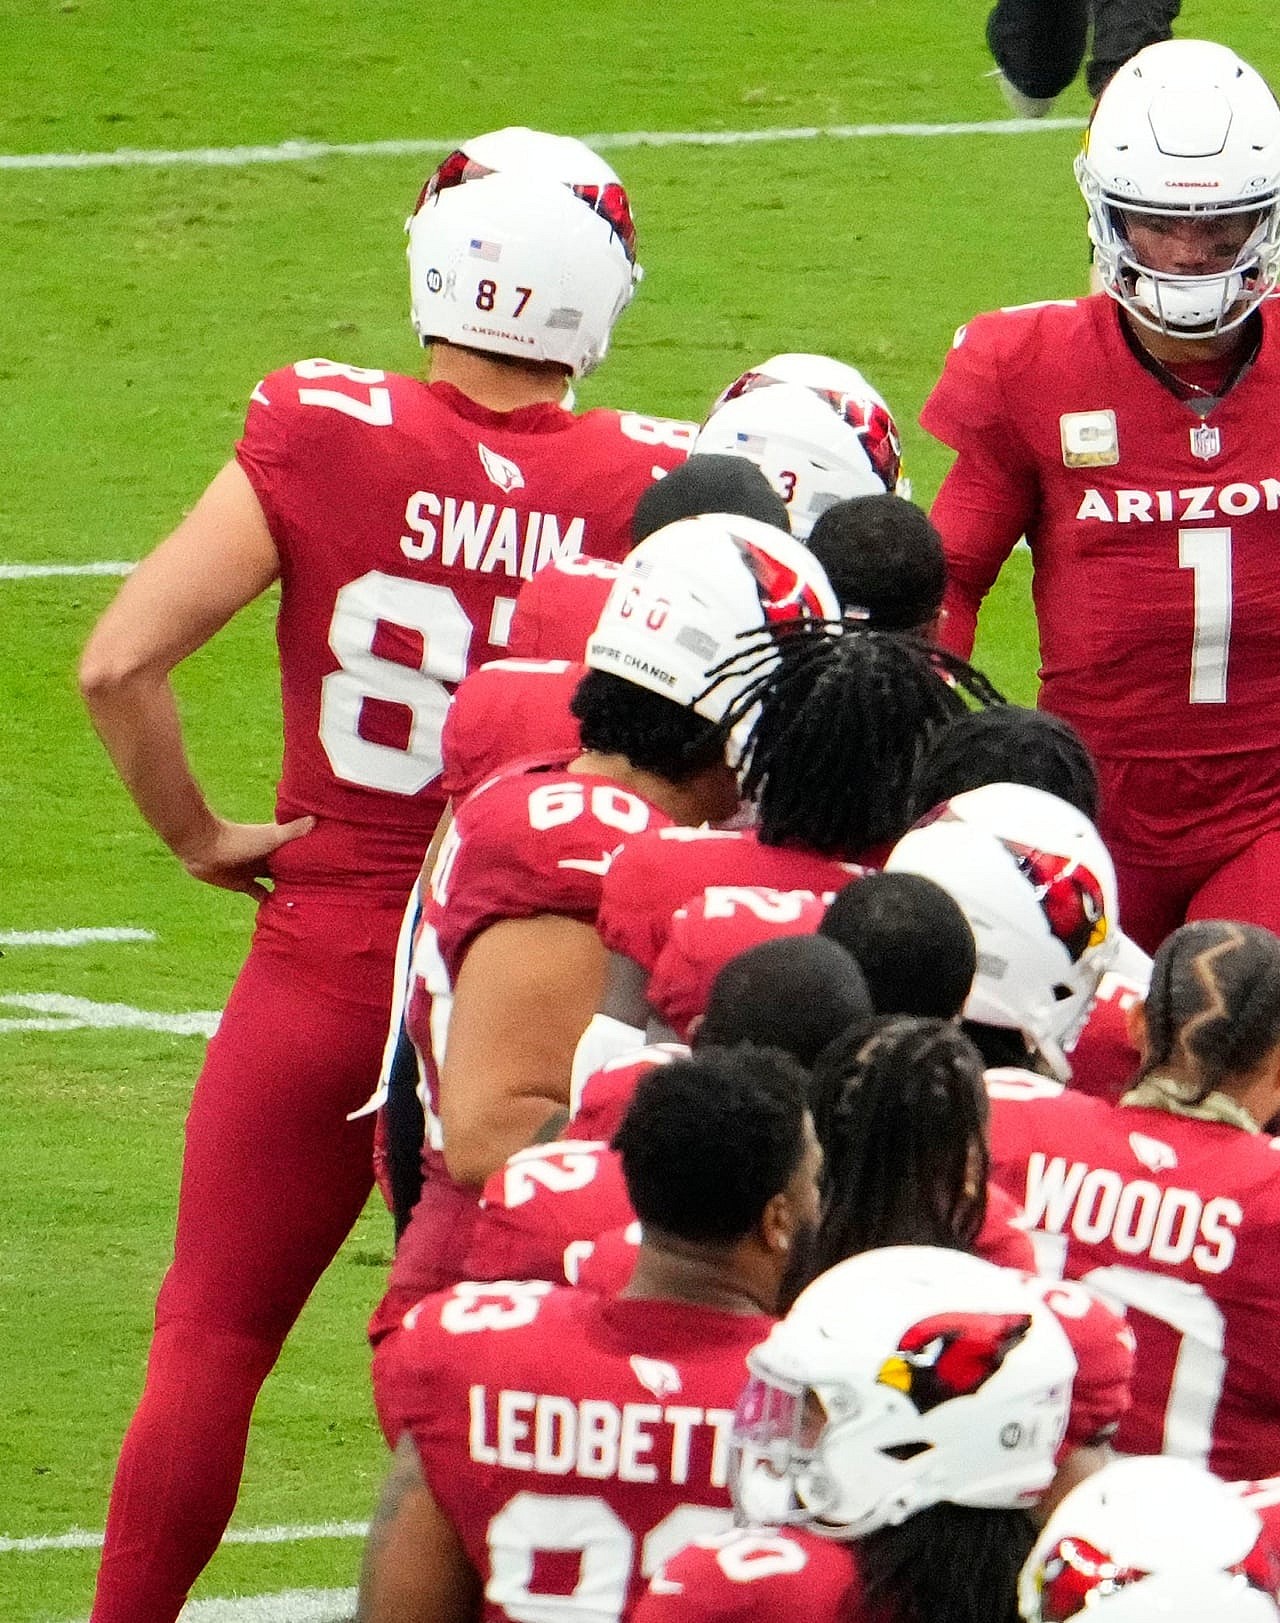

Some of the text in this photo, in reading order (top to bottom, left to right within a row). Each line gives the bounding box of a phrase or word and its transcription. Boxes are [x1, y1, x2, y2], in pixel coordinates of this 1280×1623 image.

[475, 279, 533, 318] 87
[400, 490, 586, 582] SWAIM
[1178, 526, 1232, 704] 1
[527, 781, 650, 833] 60
[1024, 1152, 1244, 1274] WOODS
